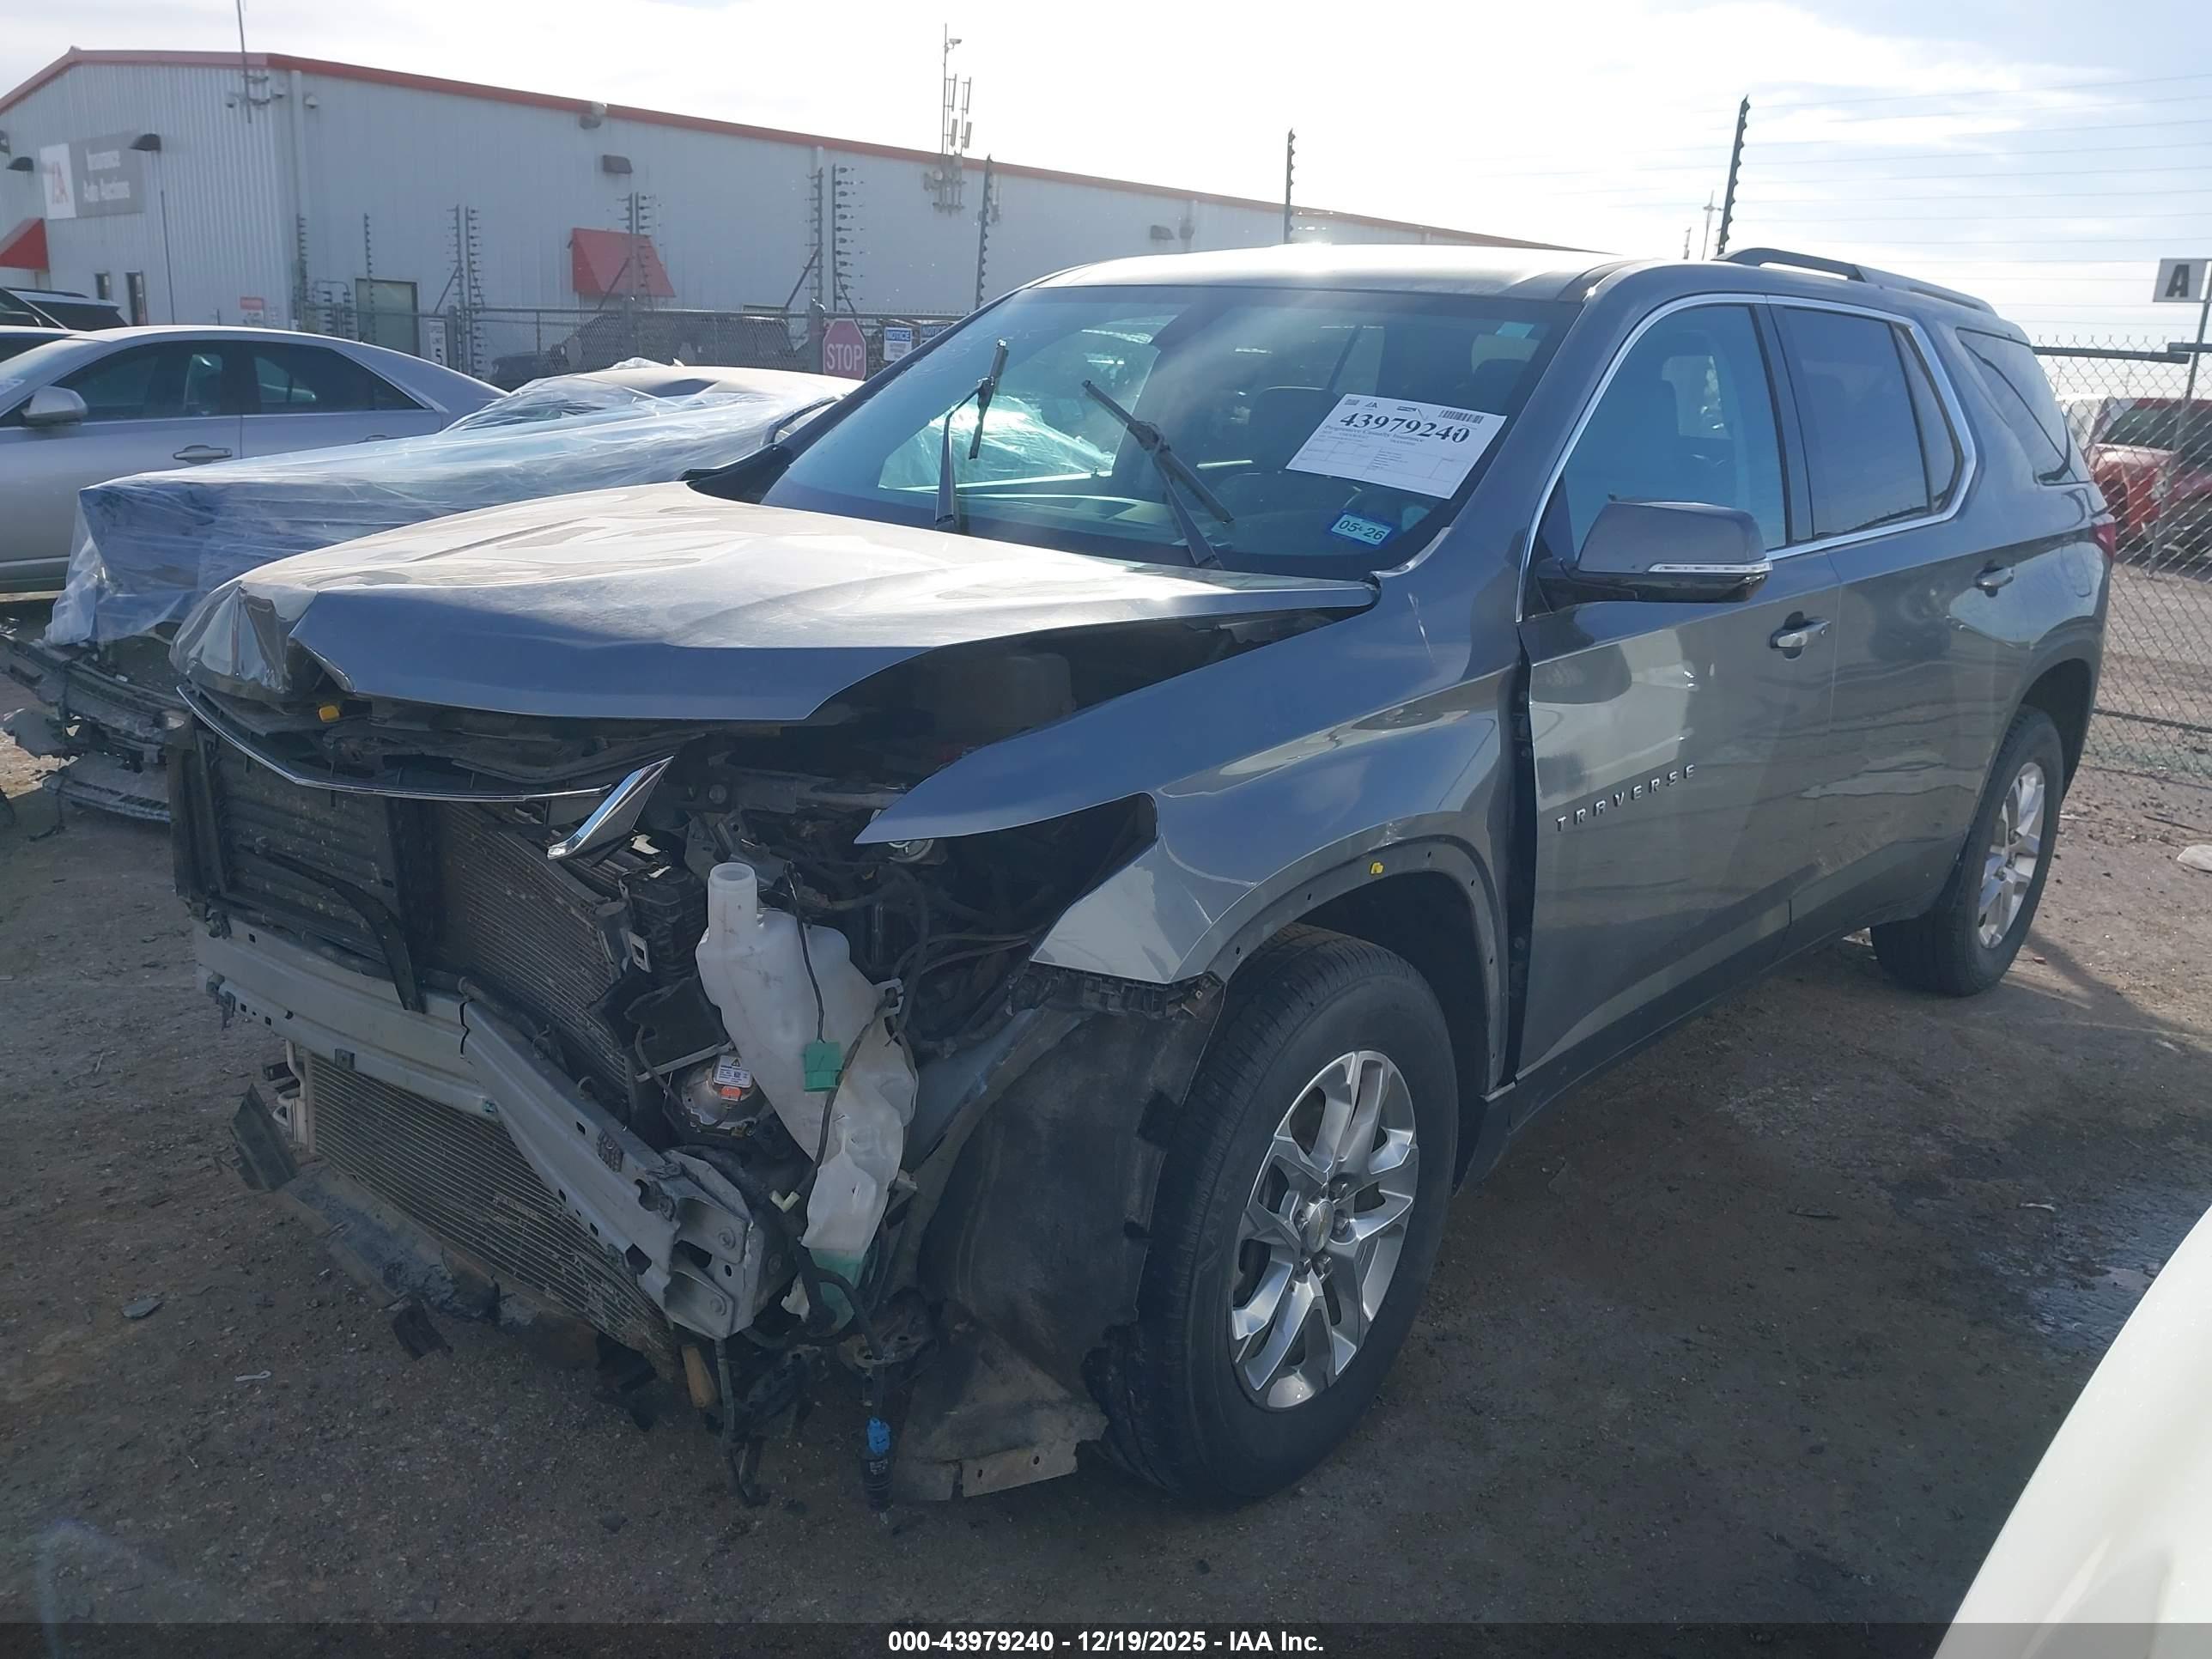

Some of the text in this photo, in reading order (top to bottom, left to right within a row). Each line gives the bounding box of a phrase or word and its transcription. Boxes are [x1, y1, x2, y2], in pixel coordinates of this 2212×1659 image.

[2165, 264, 2190, 297] A
[886, 331, 910, 340] NOTICE
[827, 343, 863, 371] STOP
[1340, 413, 1470, 443] 43979240
[1556, 763, 1696, 831] TRAVERSE
